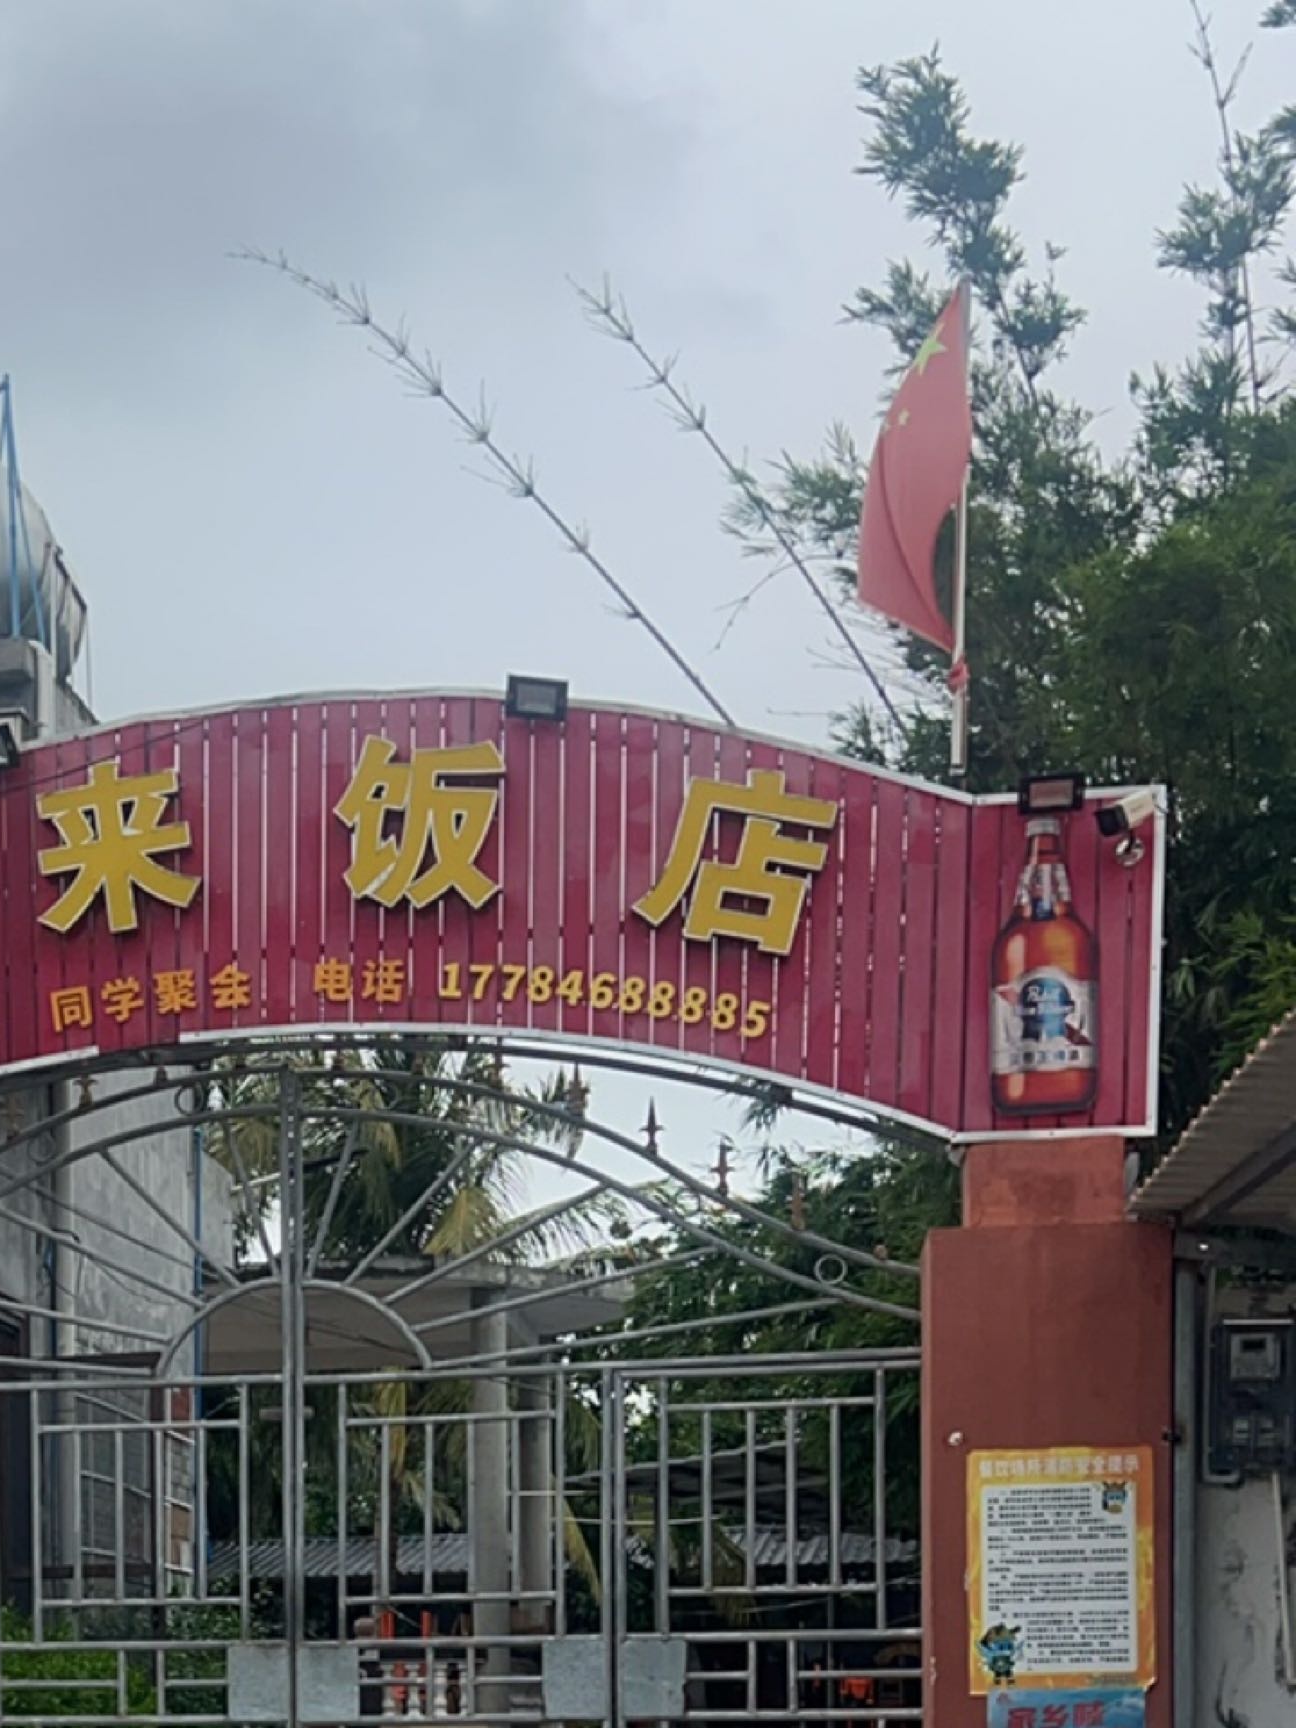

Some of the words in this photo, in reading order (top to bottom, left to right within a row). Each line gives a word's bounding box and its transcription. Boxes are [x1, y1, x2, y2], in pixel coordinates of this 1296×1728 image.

[50, 964, 252, 1032] 同学聚会
[314, 957, 405, 1002] 电话
[438, 961, 772, 1039] 17784688885
